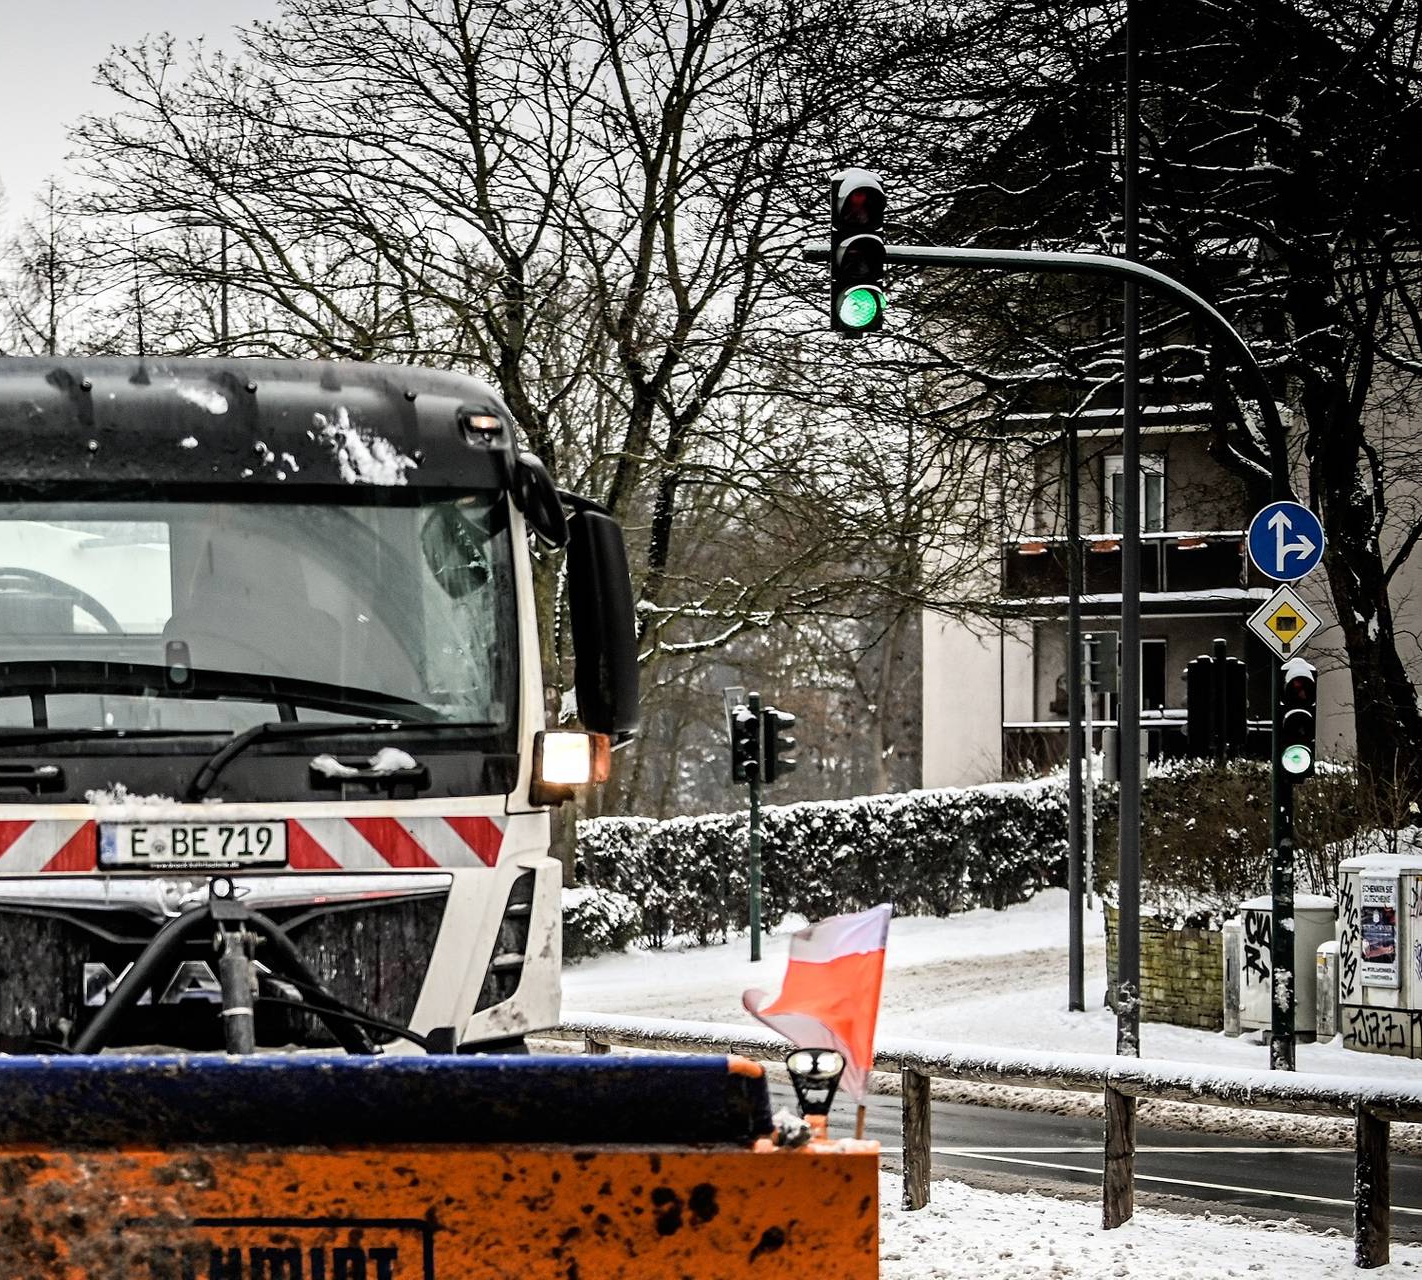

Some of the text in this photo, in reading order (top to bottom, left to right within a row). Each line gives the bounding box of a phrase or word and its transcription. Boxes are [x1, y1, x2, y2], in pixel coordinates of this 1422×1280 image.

[131, 828, 149, 857] E
[172, 827, 210, 857] BE
[218, 827, 273, 856] 719
